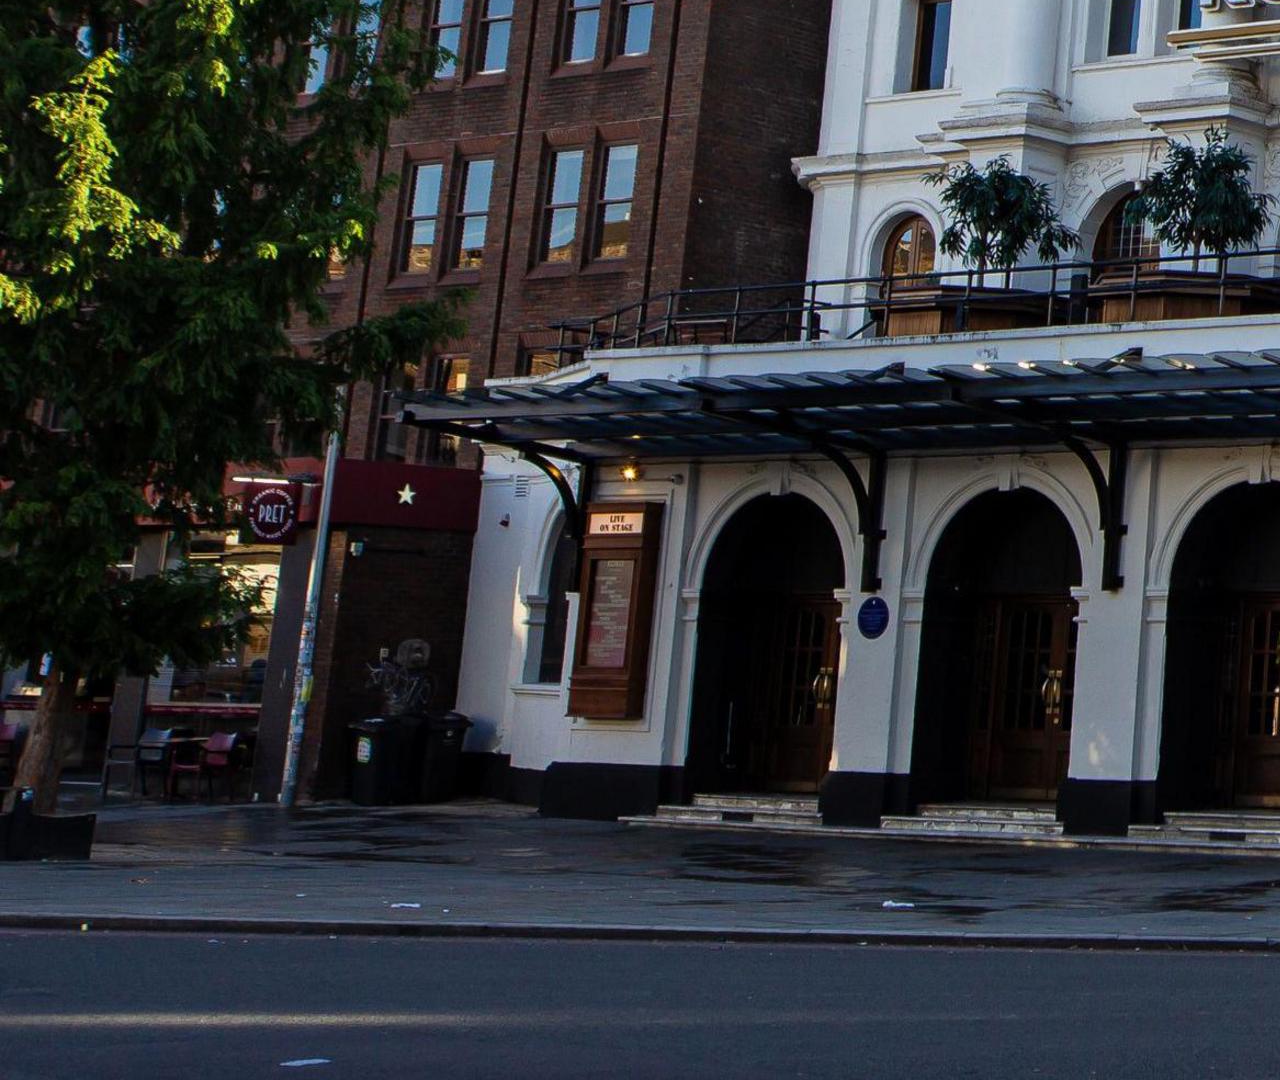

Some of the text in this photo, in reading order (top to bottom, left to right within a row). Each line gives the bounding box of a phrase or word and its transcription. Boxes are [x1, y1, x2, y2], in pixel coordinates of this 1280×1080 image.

[258, 504, 286, 524] PRET
[609, 515, 625, 523] LIVE
[599, 524, 633, 532] ON STAGE
